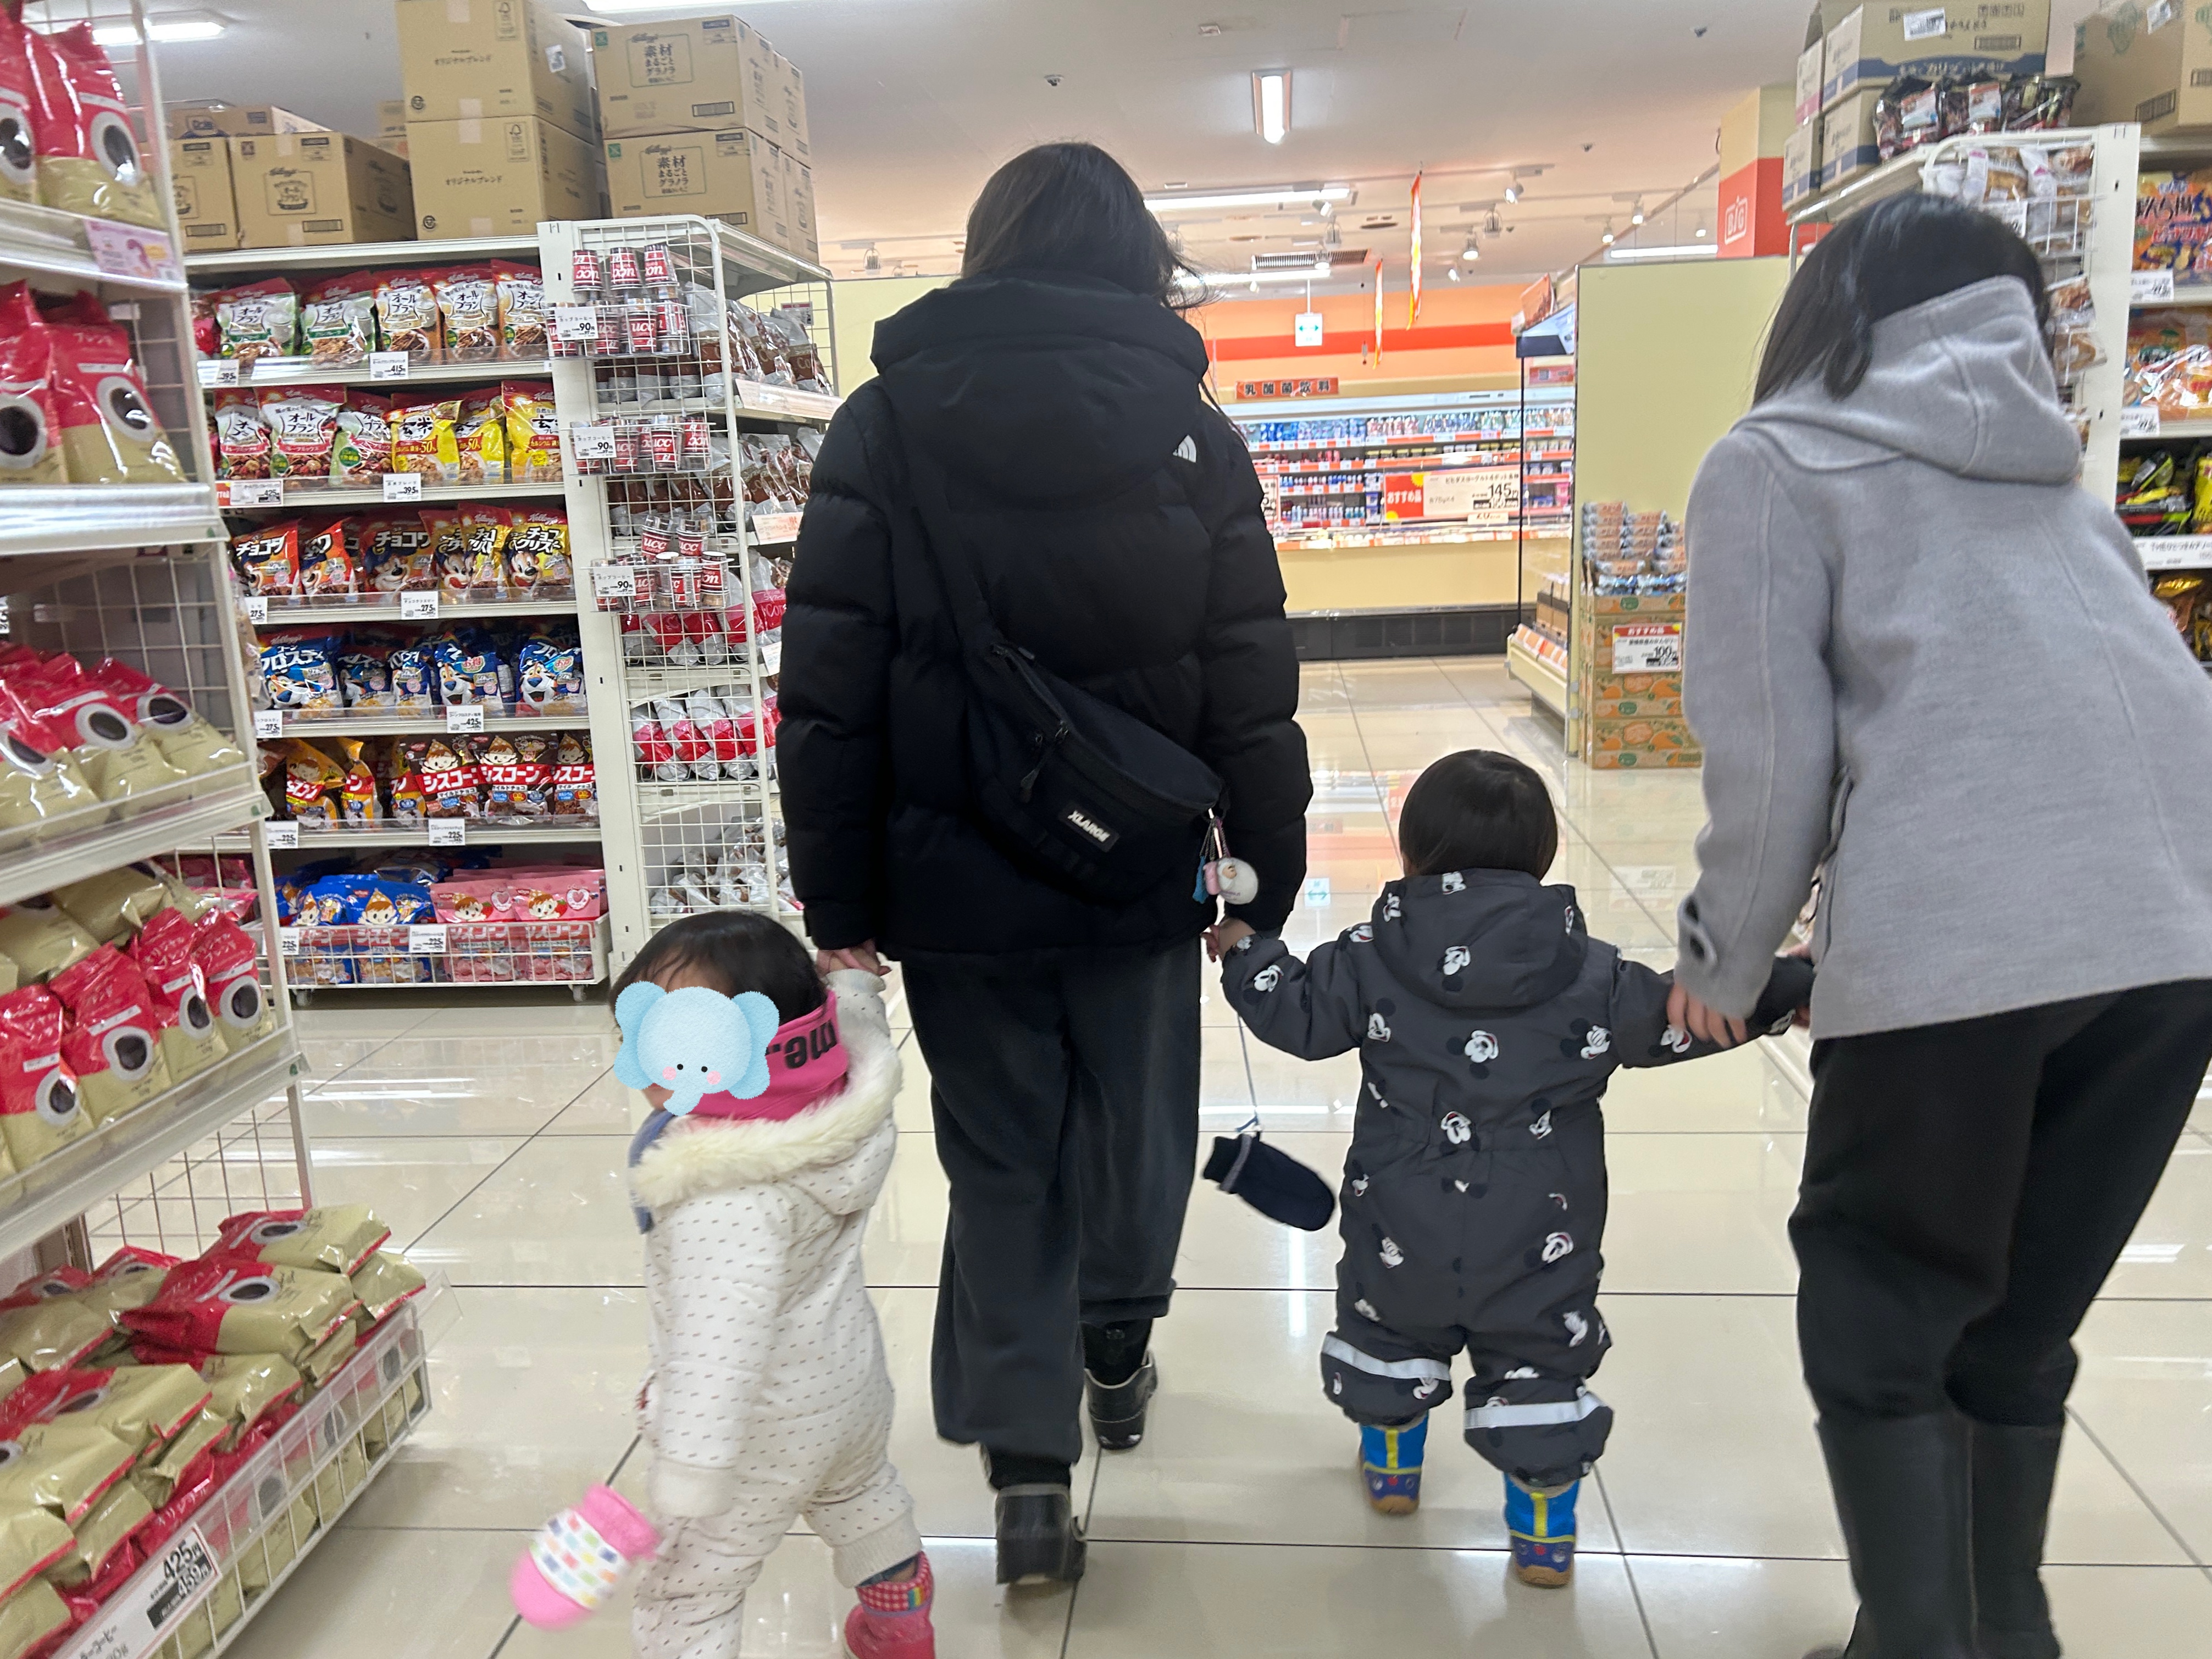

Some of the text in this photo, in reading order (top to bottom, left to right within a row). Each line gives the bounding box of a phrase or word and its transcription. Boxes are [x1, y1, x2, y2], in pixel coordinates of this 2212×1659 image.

[658, 168, 688, 177] まるごと
[659, 179, 689, 187] グラノラ
[392, 293, 416, 303] オール
[457, 290, 479, 301] オール
[454, 301, 479, 310] ブラン
[579, 323, 595, 331] 90円
[1244, 379, 1329, 396] 乳酸菌飲料
[289, 413, 316, 422] オール
[402, 417, 433, 435] 玄米
[597, 442, 613, 450] 90円
[1387, 489, 1422, 504] おすすめ品
[375, 530, 431, 548] チョコワ
[617, 581, 633, 589] 90円
[480, 765, 540, 784] シスコーン
[164, 1539, 202, 1579] 425円
